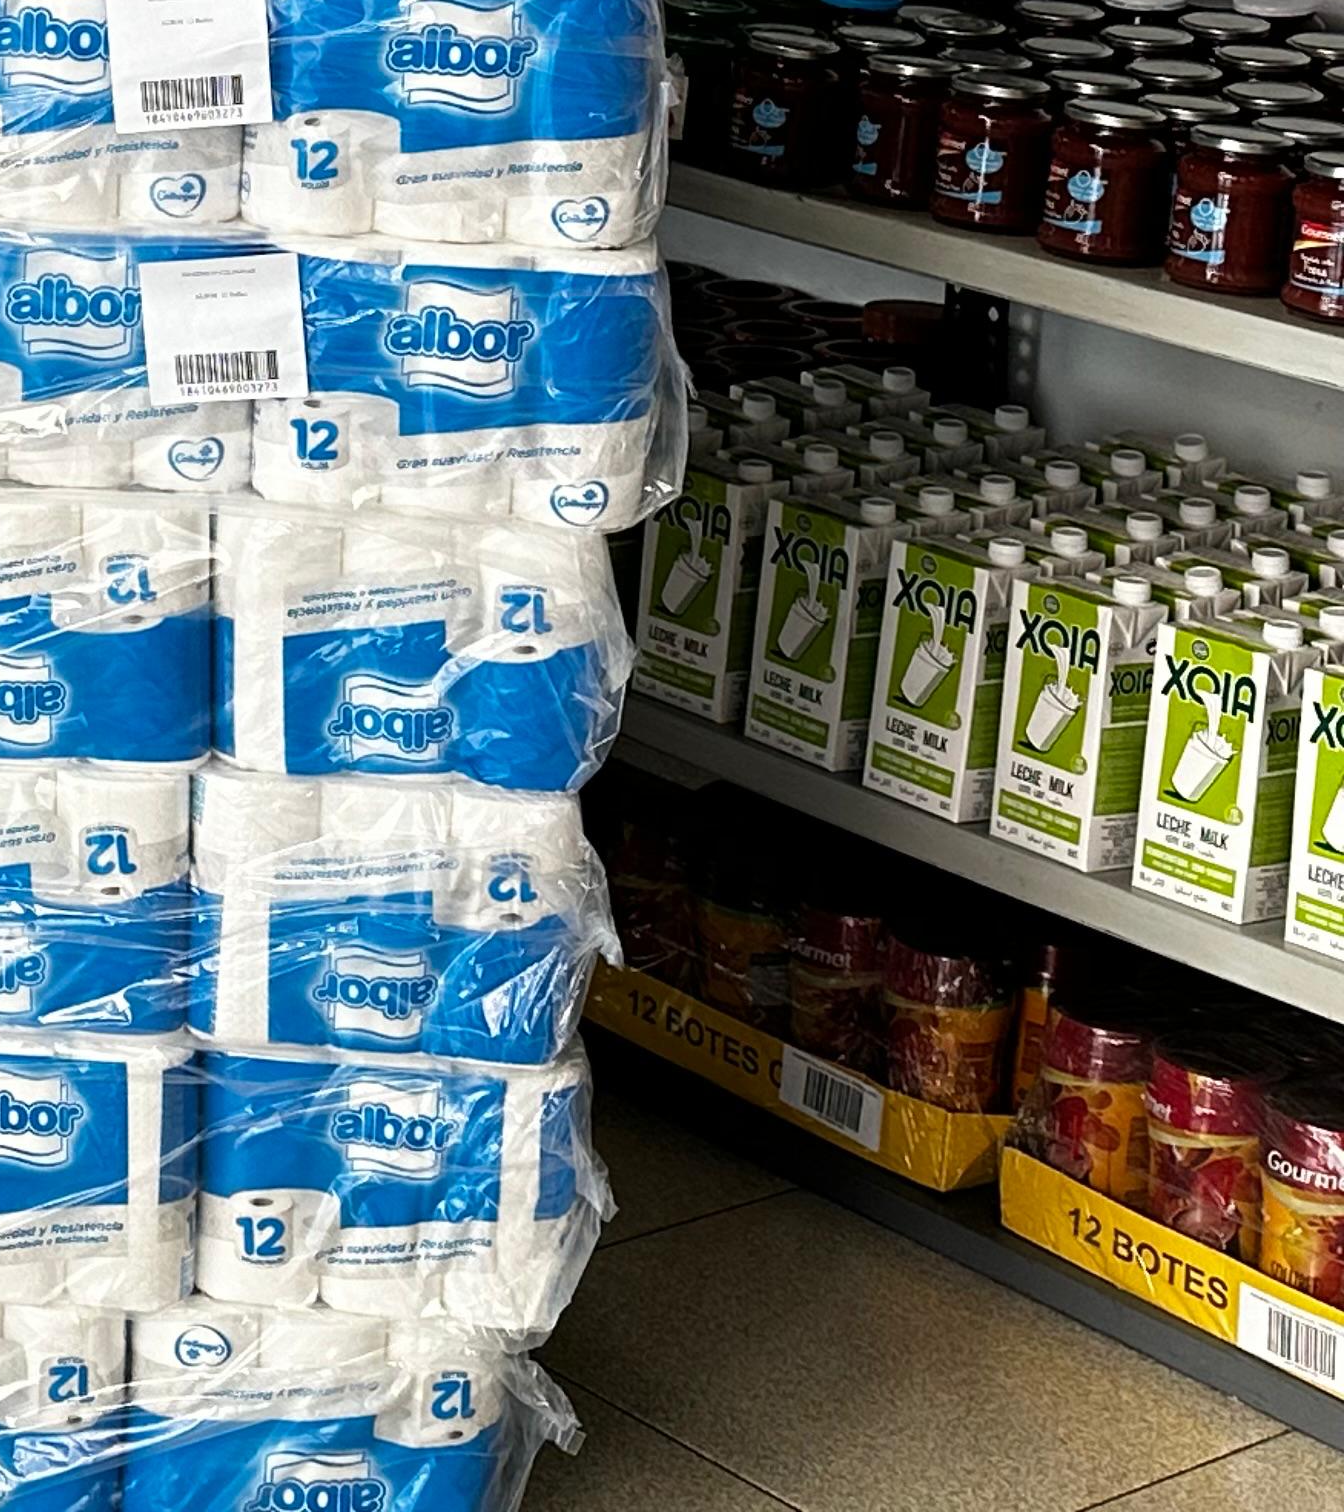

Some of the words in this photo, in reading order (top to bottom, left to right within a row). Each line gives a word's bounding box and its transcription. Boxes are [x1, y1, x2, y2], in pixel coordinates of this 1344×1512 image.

[386, 26, 537, 77] albor
[291, 139, 339, 181] 12
[384, 307, 534, 361] albor
[291, 420, 339, 461] 12
[771, 526, 849, 590] XOIA
[106, 560, 157, 602] 12
[892, 568, 978, 635] XOIA
[501, 590, 553, 633] 12
[1016, 609, 1100, 675] XOIA
[1161, 655, 1257, 724] XOIA
[329, 704, 453, 751] albor
[1011, 761, 1043, 789] LECHE
[1157, 812, 1191, 840] LECHE
[86, 833, 138, 876] 12
[488, 862, 538, 902] 12
[314, 973, 437, 1018] albor
[627, 989, 657, 1025] 12
[664, 1007, 760, 1080] BOTES
[334, 1105, 458, 1150] albor
[236, 1218, 285, 1258] 12
[1067, 1207, 1101, 1247] 12
[1113, 1227, 1230, 1311] BOTES
[48, 1365, 94, 1403] 12
[431, 1380, 477, 1419] 12
